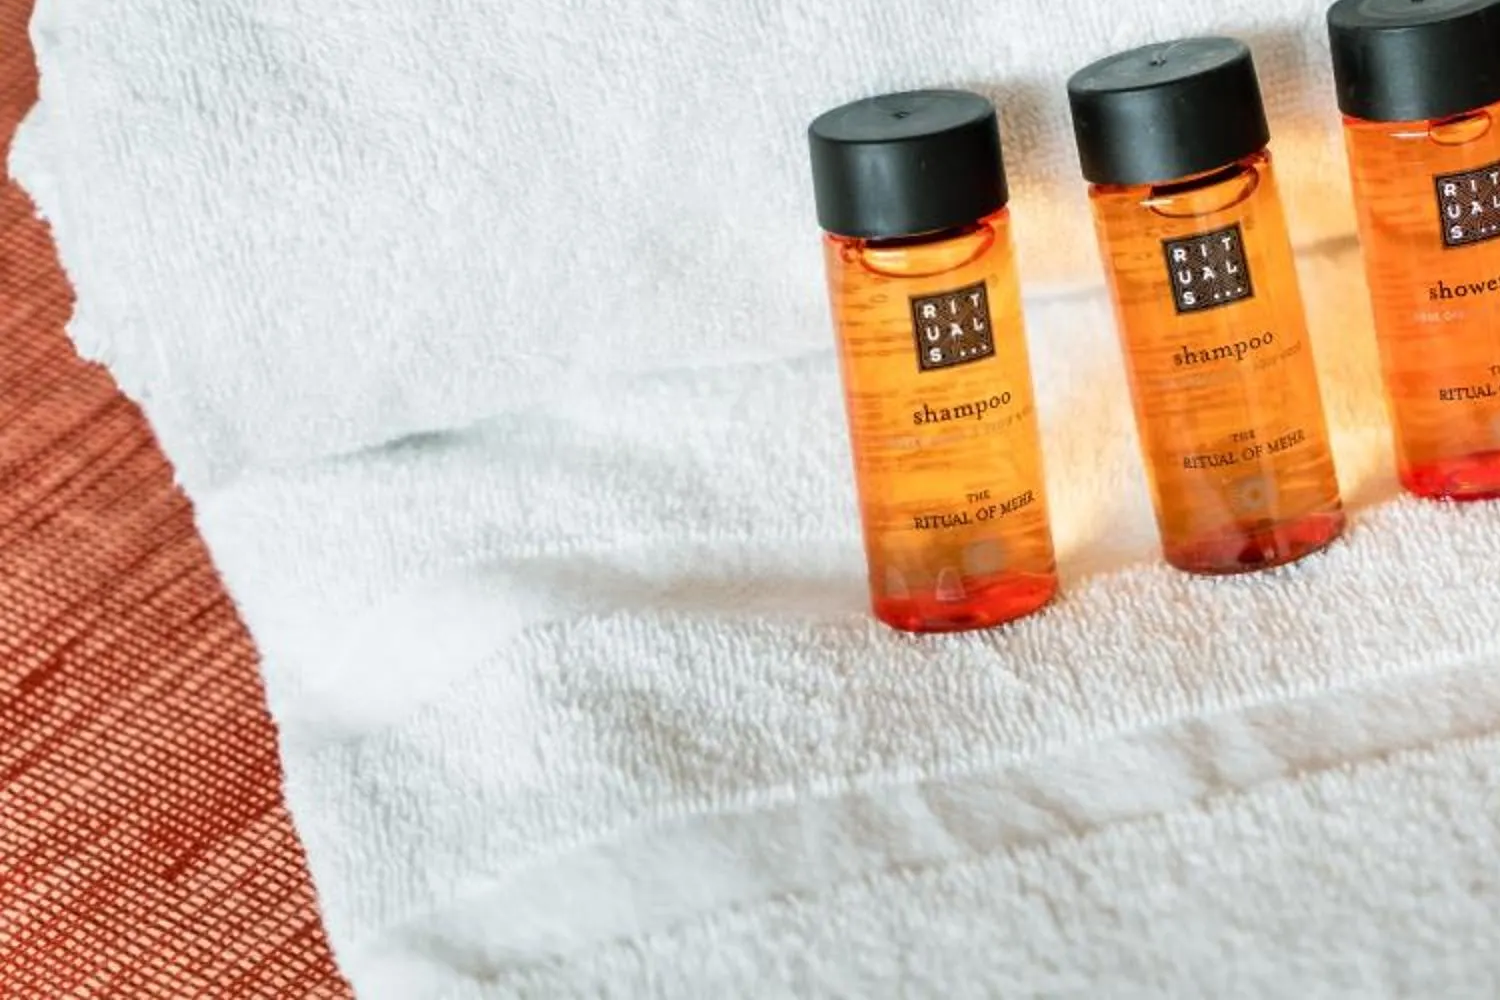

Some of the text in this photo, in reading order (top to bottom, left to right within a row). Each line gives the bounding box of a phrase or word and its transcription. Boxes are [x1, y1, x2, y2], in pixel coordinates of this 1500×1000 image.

[1173, 331, 1274, 366] shampoo
[1439, 383, 1497, 401] RITUAL
[913, 391, 1012, 425] shampoo
[1230, 429, 1256, 443] THE
[1183, 452, 1238, 469] RITUAL
[1242, 447, 1263, 461] OF
[966, 489, 991, 504] THE
[913, 511, 974, 530] RITUAL
[975, 505, 996, 522] OF
